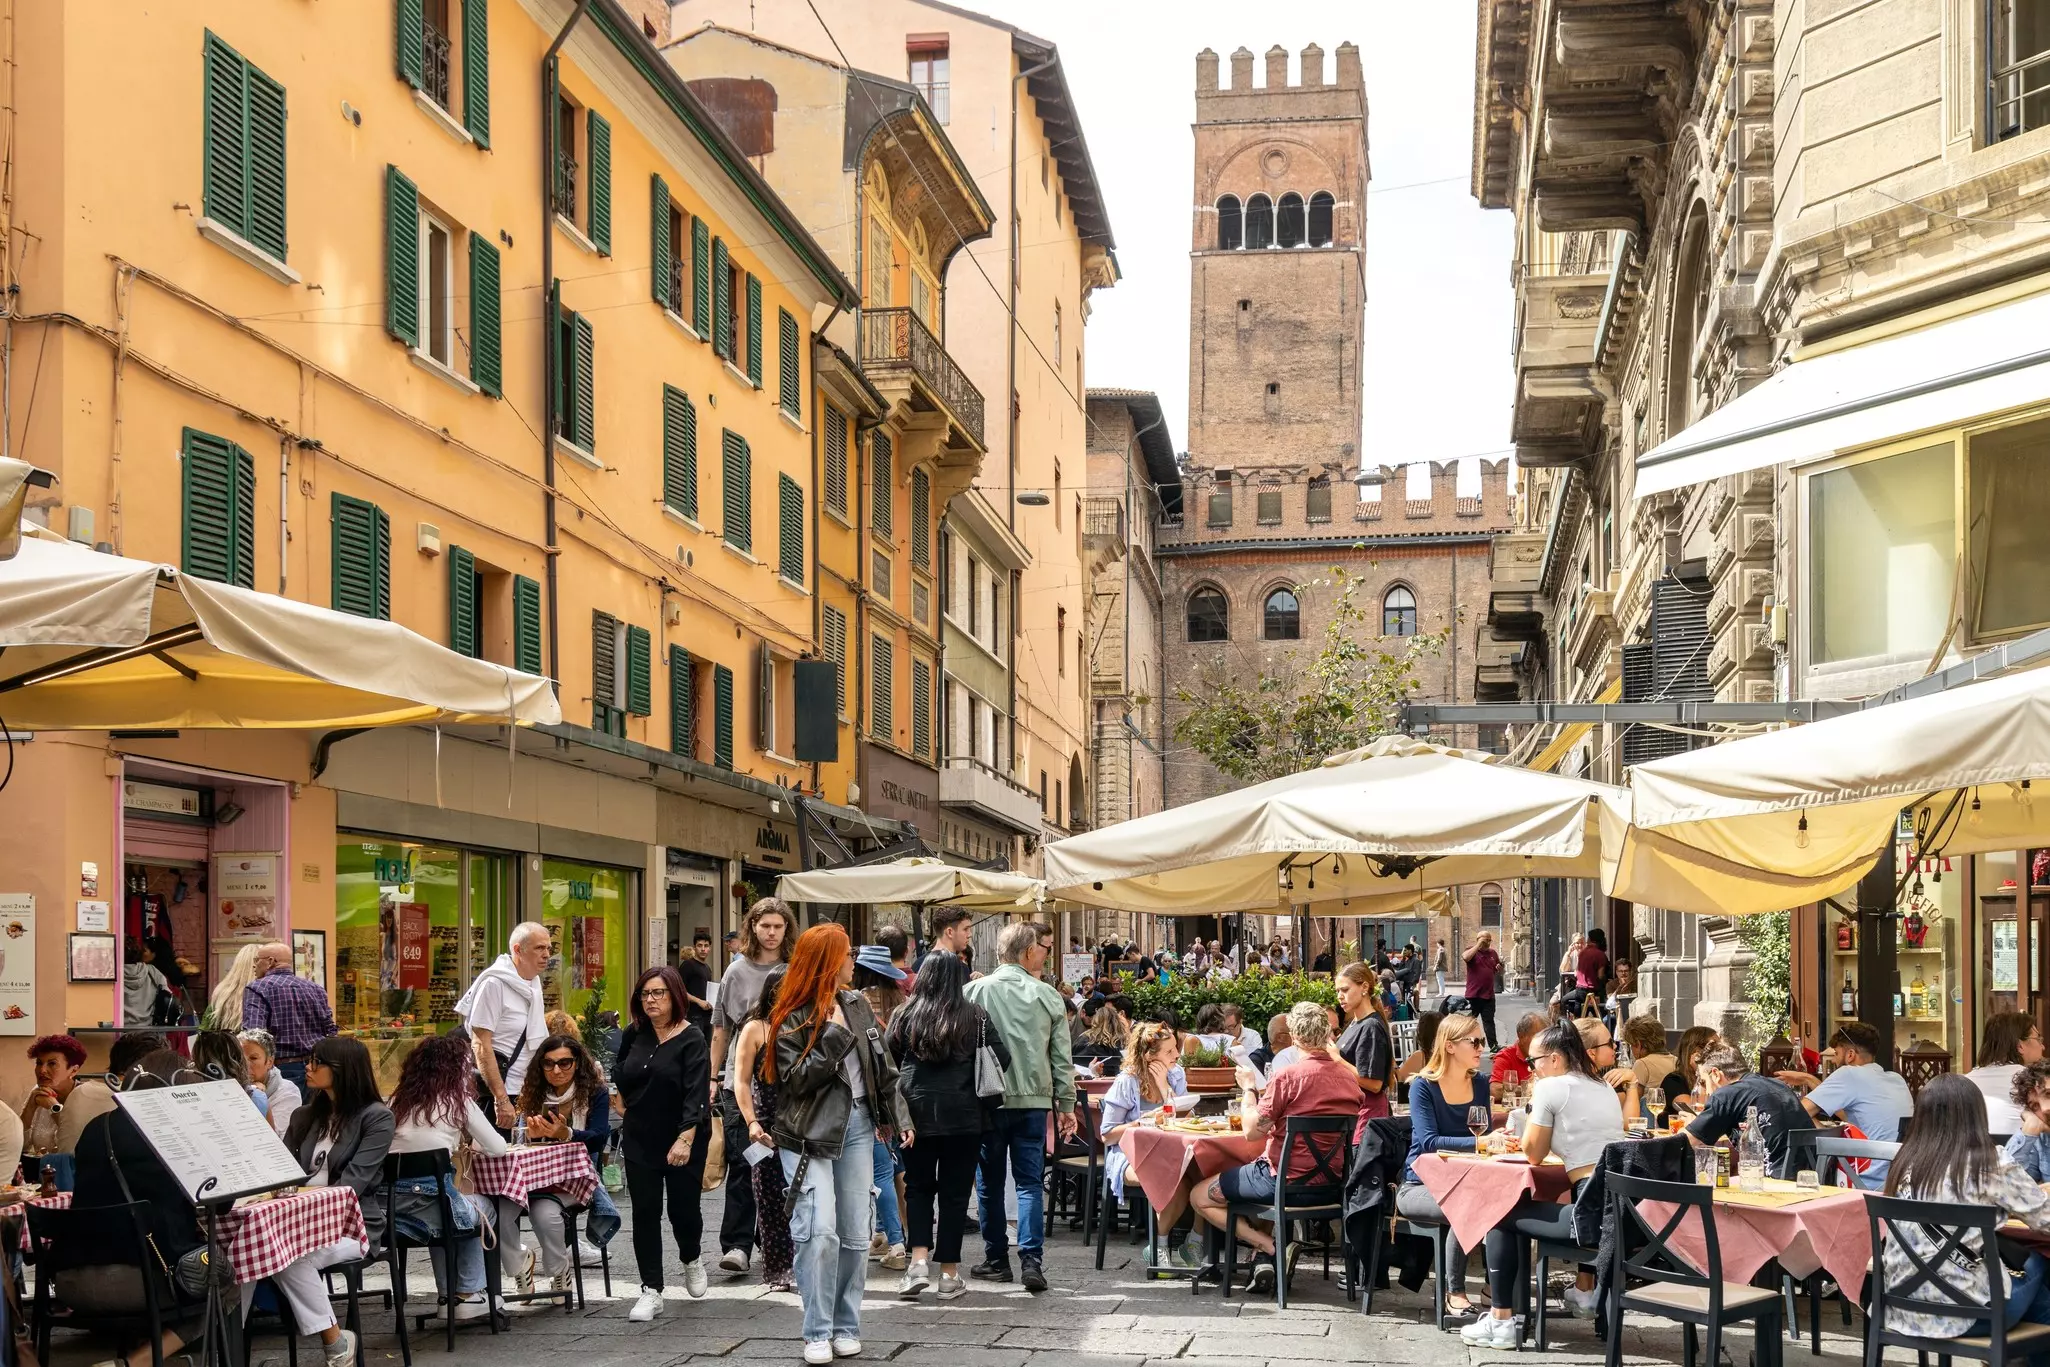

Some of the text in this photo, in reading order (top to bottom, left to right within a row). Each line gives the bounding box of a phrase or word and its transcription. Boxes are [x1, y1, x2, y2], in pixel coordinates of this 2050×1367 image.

[135, 799, 175, 810] CHAMPAGNE
[755, 827, 791, 854] AROMA
[402, 921, 419, 932] BACK
[403, 945, 422, 960] €49
[587, 952, 600, 965] €49
[171, 1089, 198, 1099] Osteria
